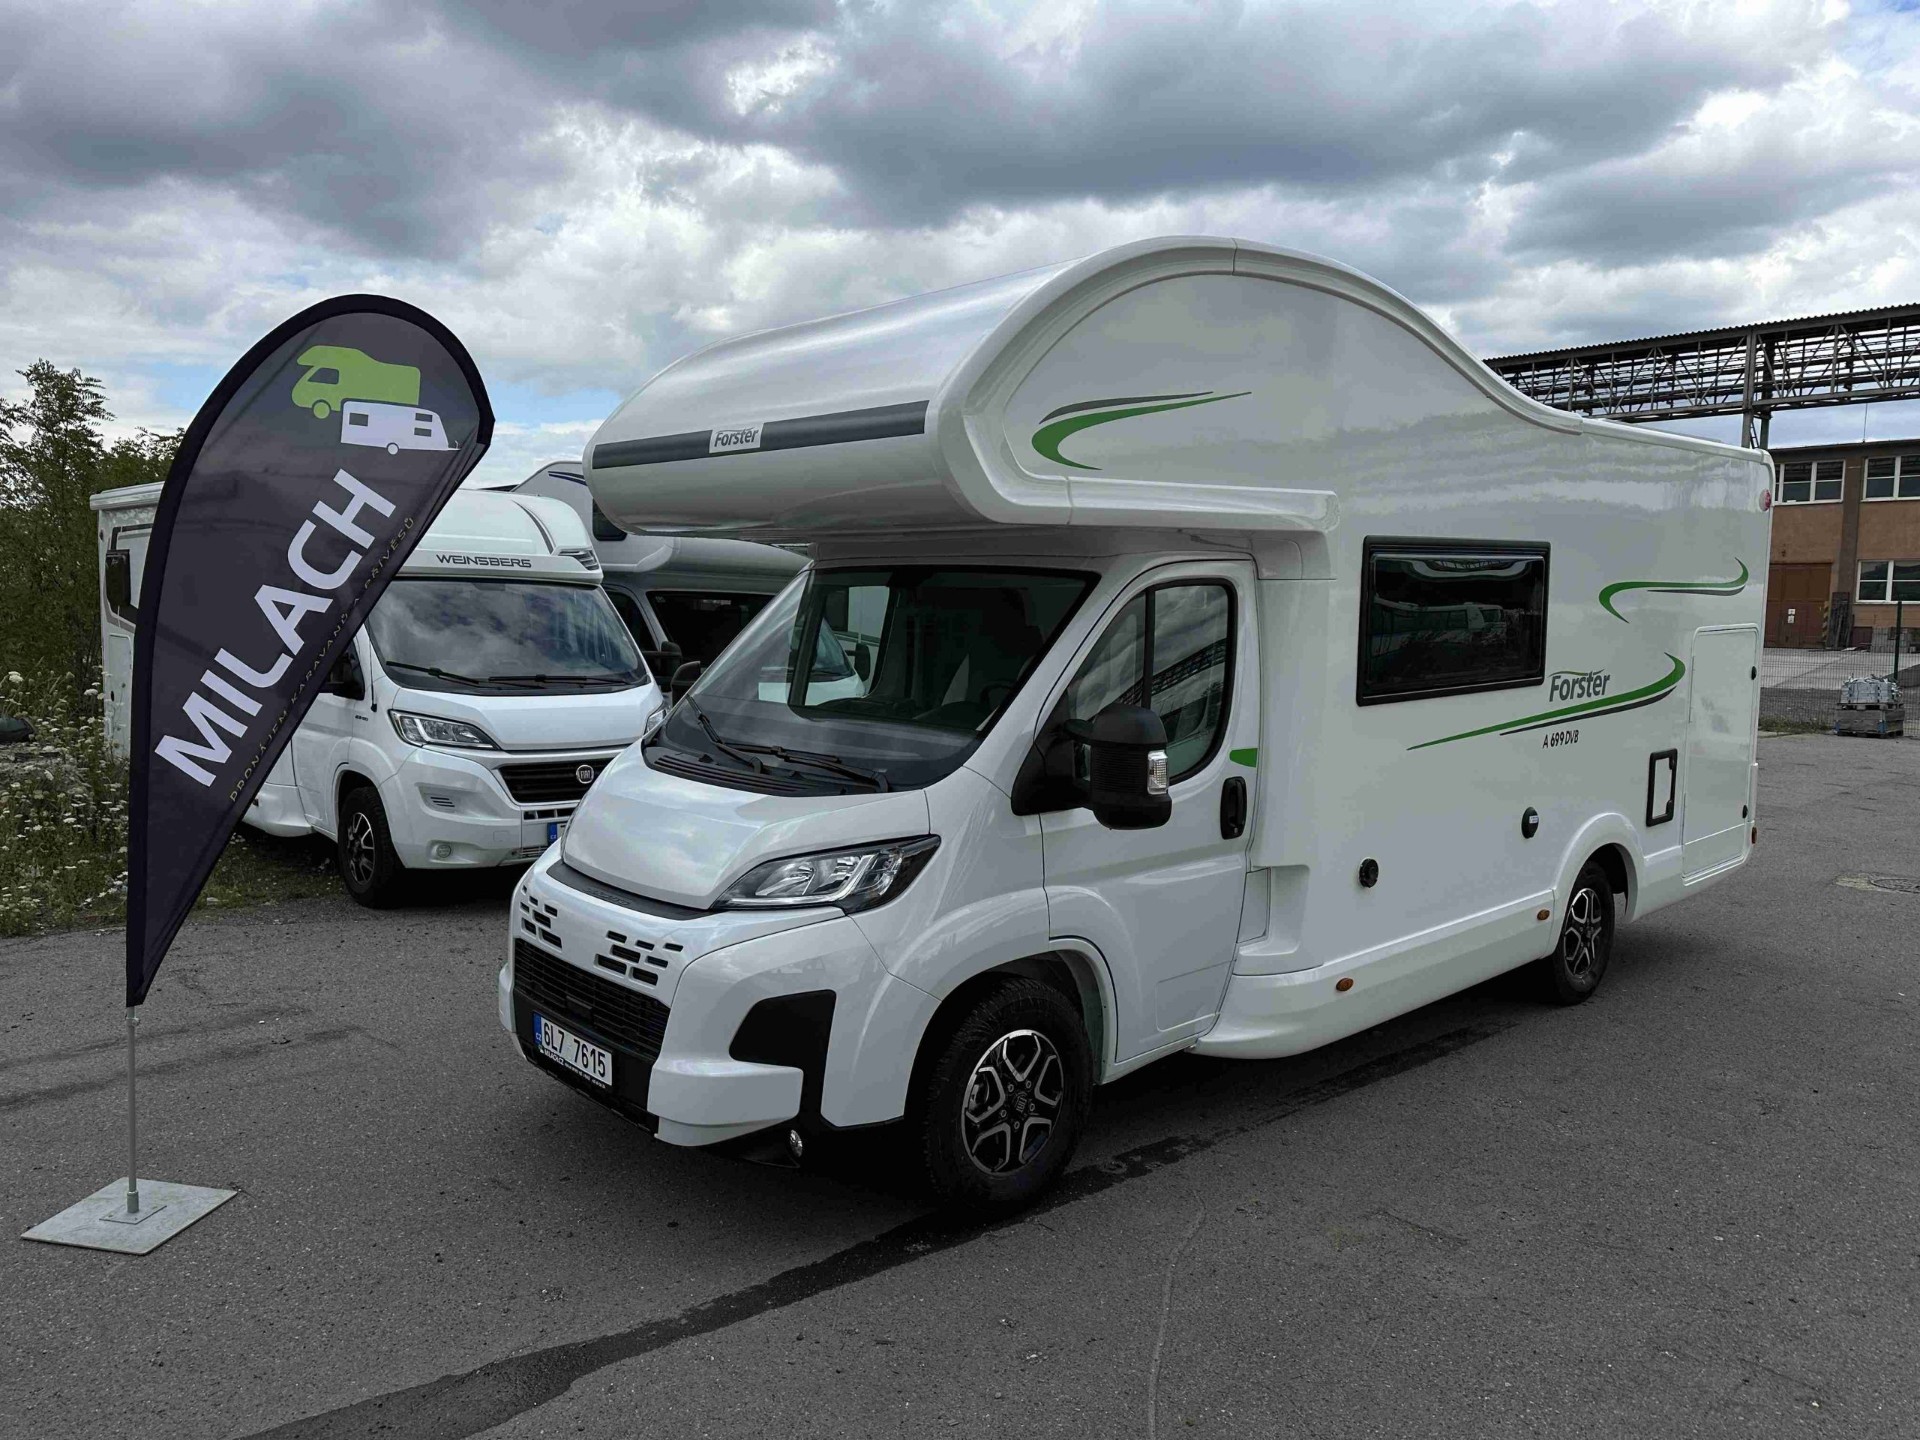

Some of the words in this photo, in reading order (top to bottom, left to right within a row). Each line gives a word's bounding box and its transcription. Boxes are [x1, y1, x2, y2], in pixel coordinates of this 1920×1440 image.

[714, 428, 759, 447] Forster
[436, 554, 532, 568] WEINSBERG
[154, 468, 397, 787] MILACH
[1549, 671, 1611, 702] Forster
[1542, 734, 1549, 749] A
[1550, 731, 1565, 747] 699
[1565, 730, 1579, 745] DVB
[543, 1022, 565, 1054] 6L7
[573, 1038, 606, 1078] 7615
